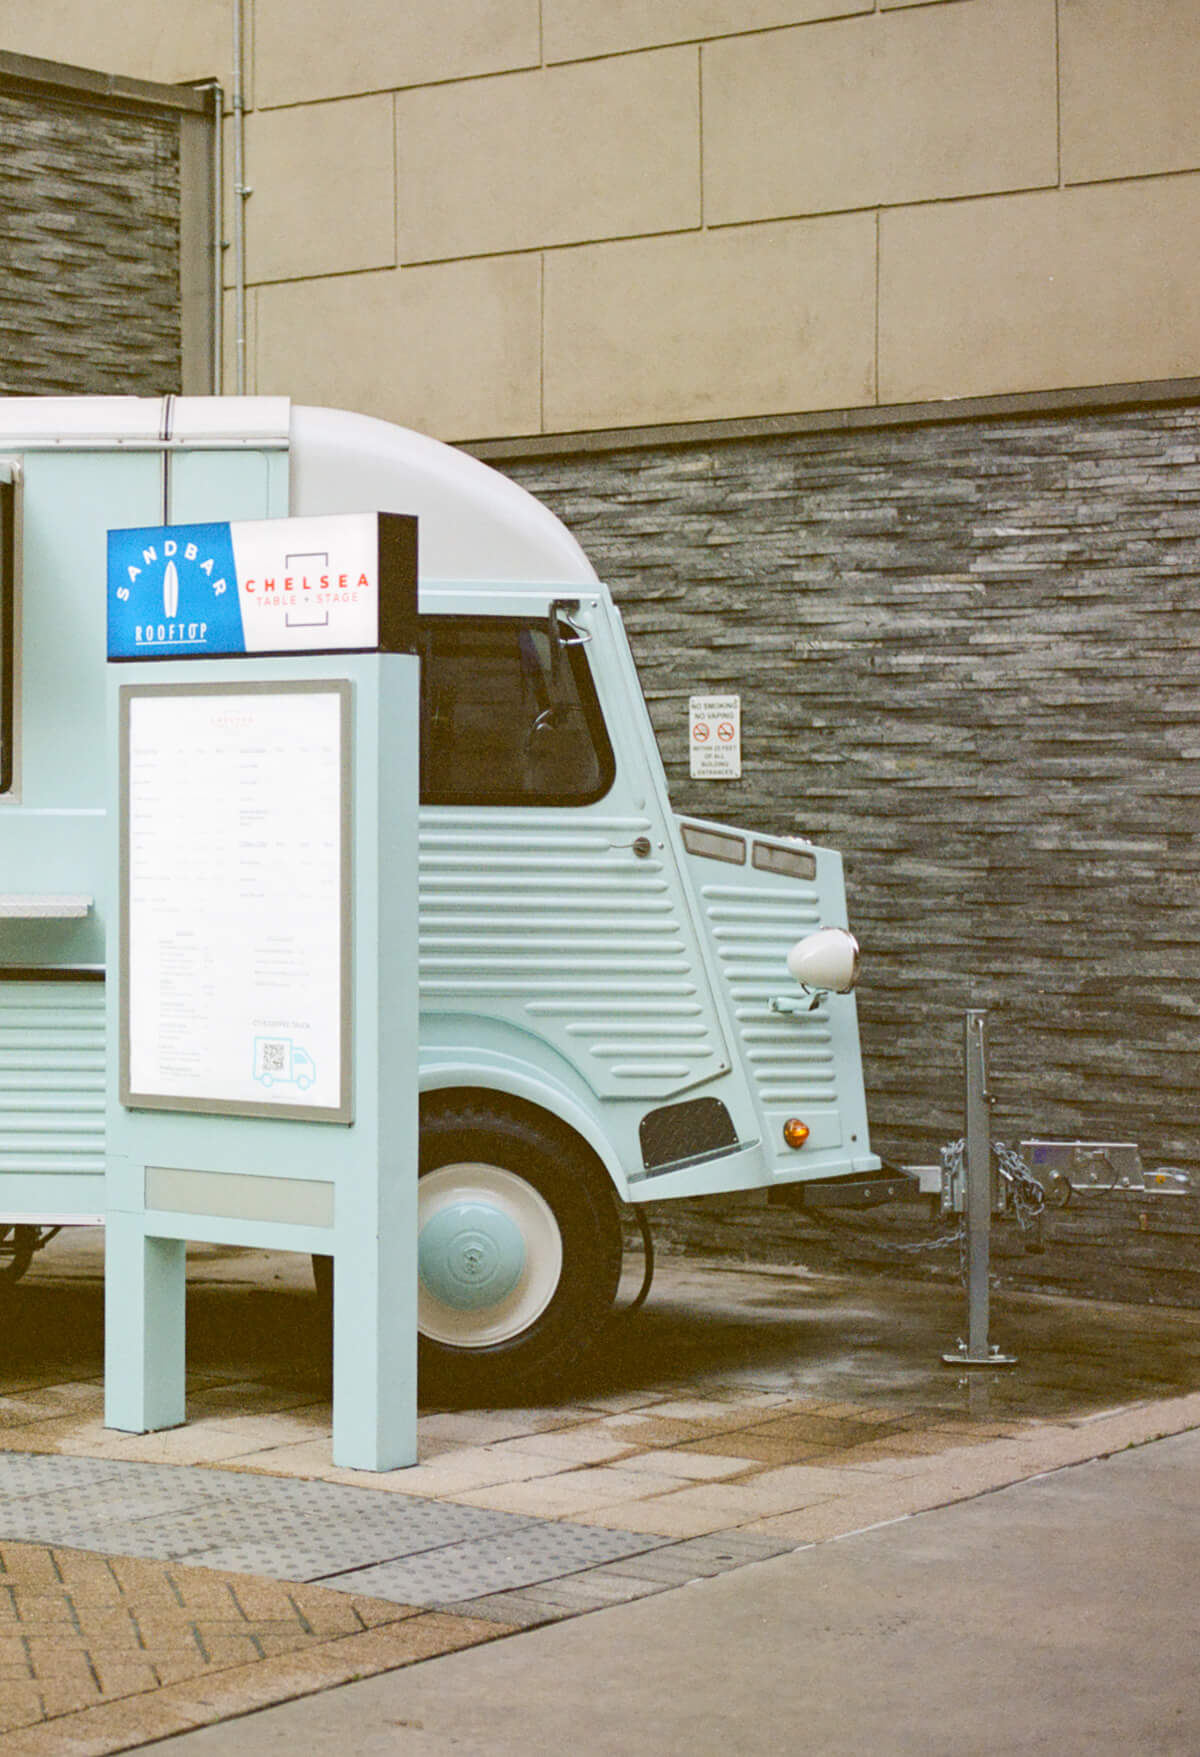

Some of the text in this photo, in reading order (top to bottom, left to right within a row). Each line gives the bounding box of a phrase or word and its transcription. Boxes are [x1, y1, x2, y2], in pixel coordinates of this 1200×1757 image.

[116, 540, 227, 602] SANDBAR
[245, 573, 369, 593] CHELSEA
[256, 594, 297, 606] TABLE
[316, 591, 360, 604] STAGE
[135, 622, 207, 642] ROOFTOP
